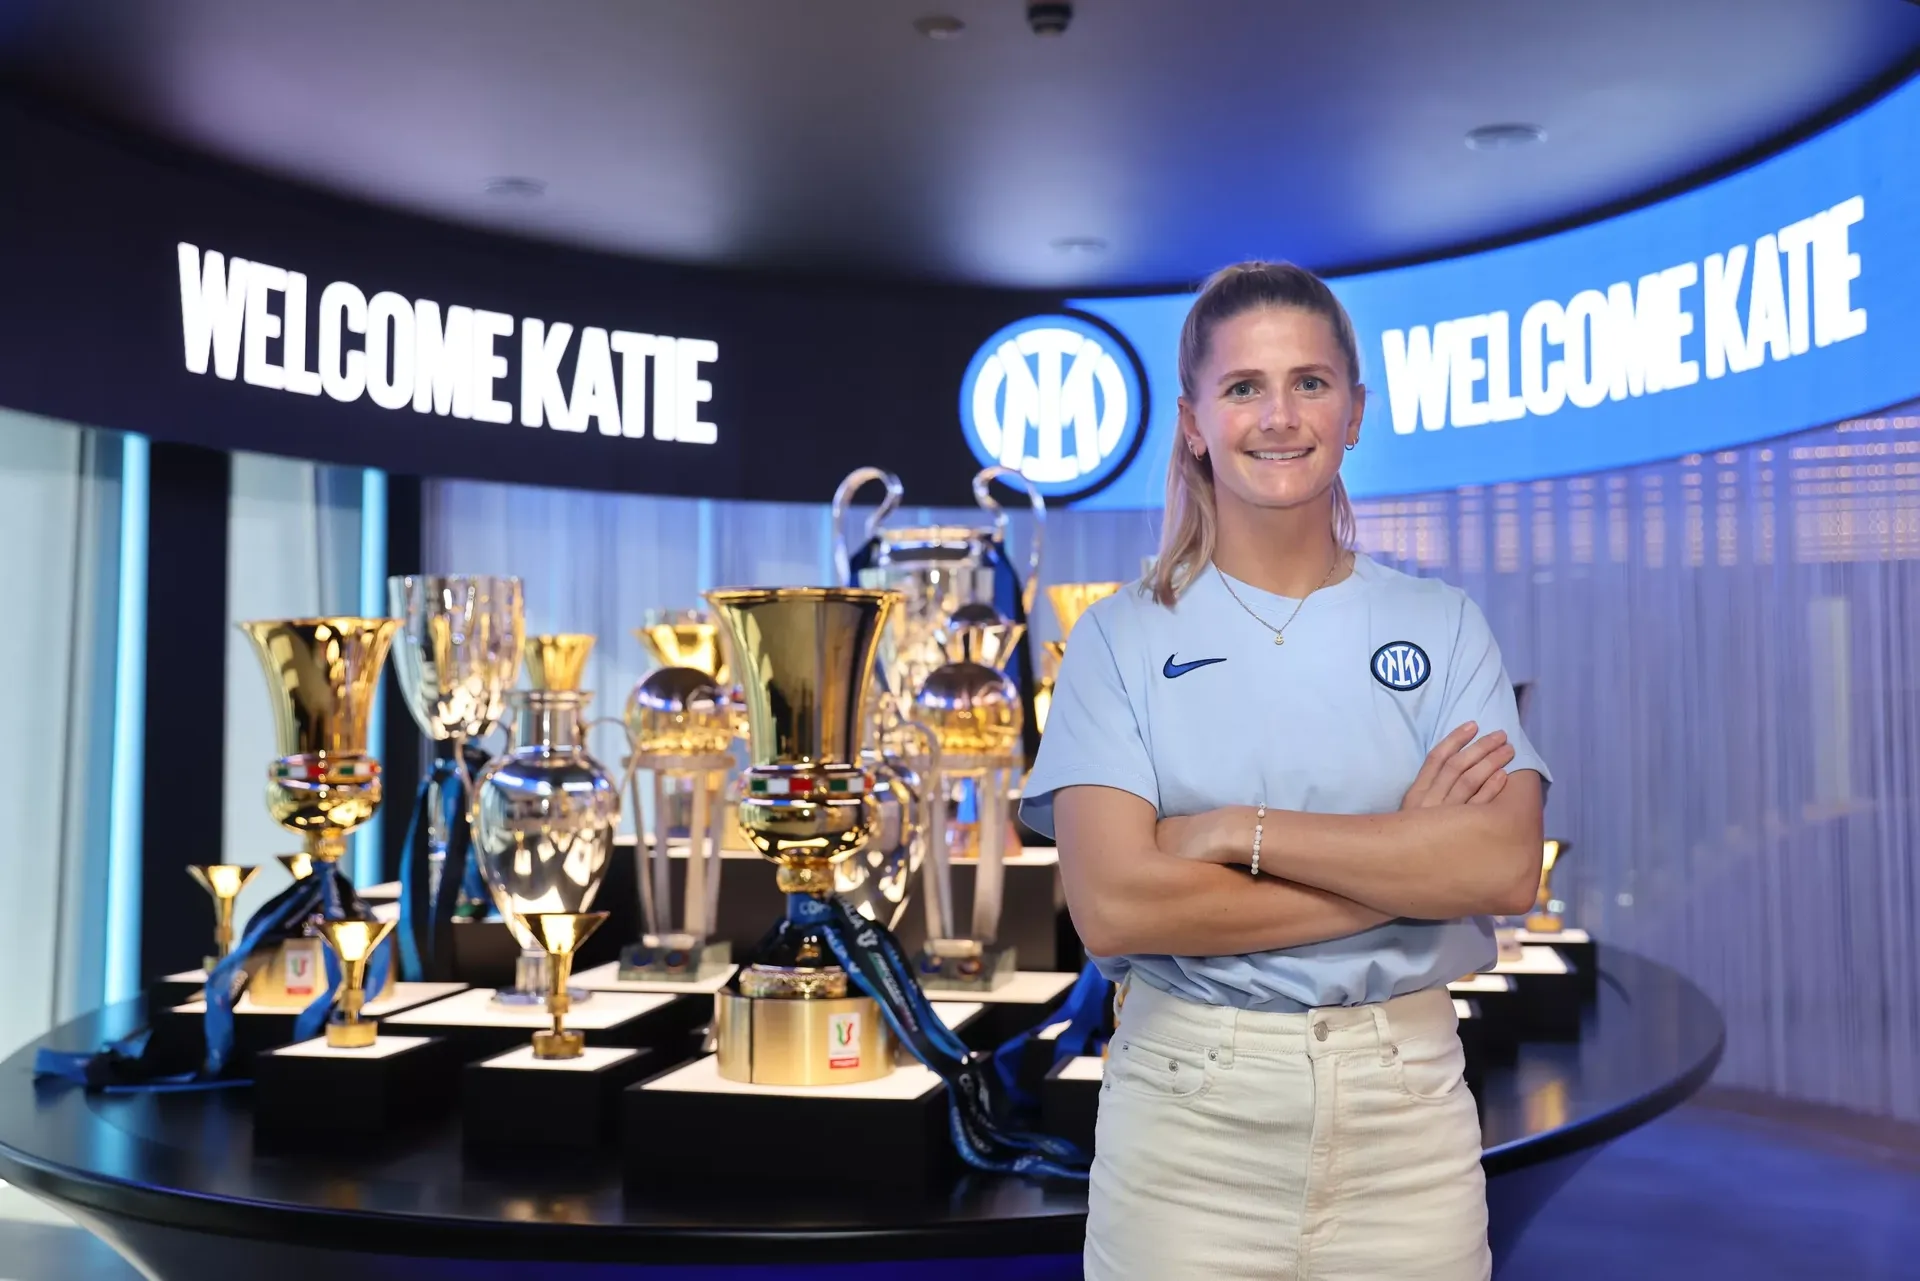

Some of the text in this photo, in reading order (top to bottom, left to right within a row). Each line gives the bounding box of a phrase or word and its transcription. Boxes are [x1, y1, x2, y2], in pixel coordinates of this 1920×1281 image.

[178, 242, 719, 444] WELCOME KATIE
[1382, 196, 1867, 434] WELCOME KATIE
